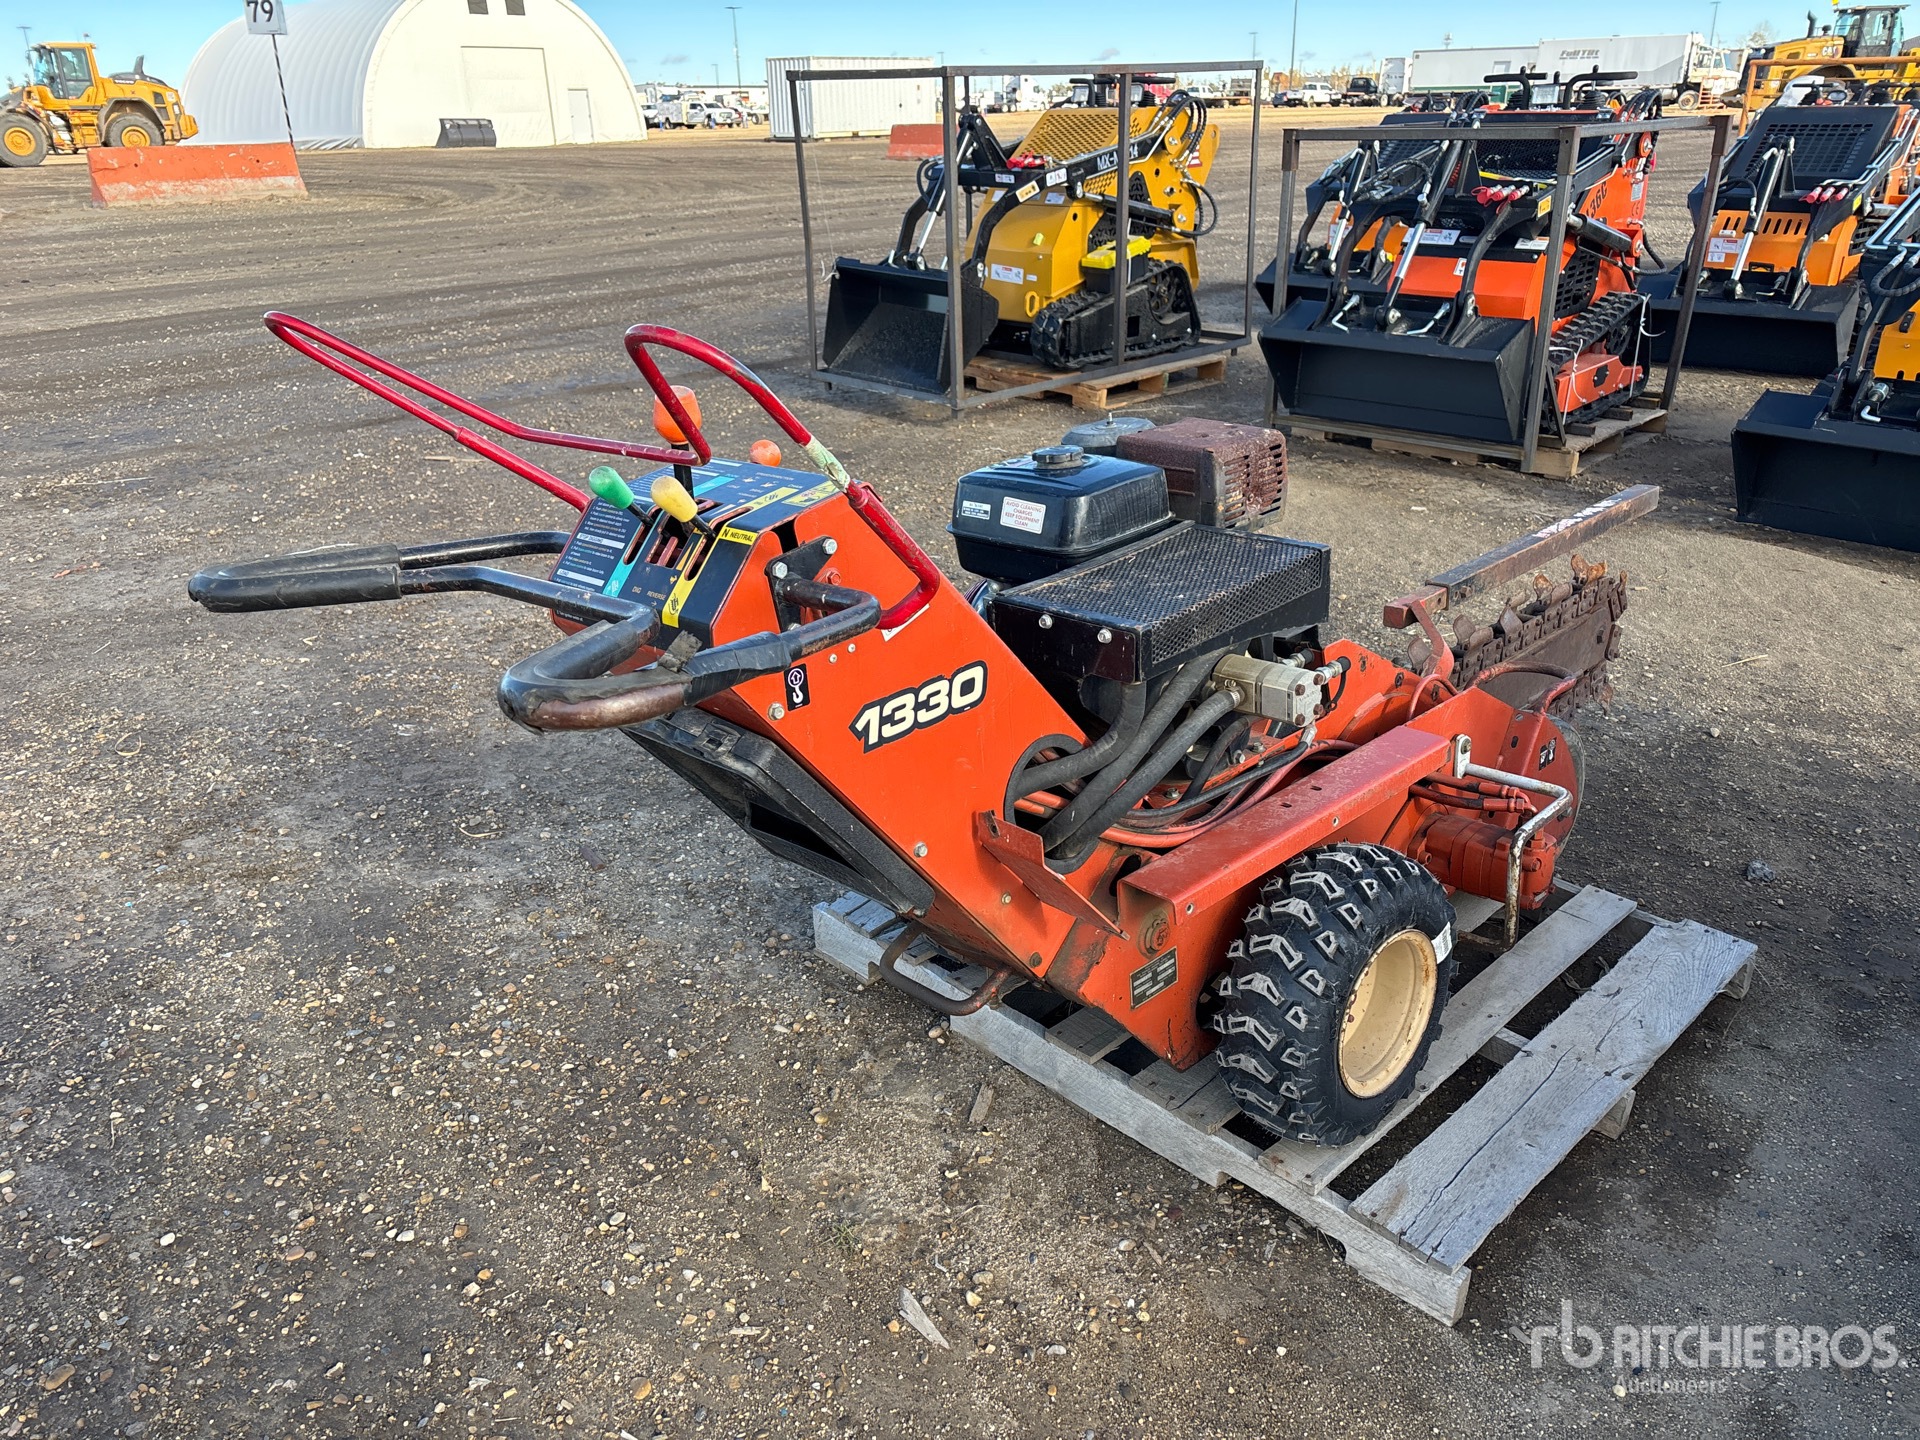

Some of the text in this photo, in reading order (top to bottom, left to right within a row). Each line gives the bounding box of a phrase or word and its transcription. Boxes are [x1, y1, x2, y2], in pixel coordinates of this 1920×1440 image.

[247, 0, 274, 23] 79
[1013, 508, 1033, 517] CHARGES
[1020, 503, 1043, 513] CLEANING
[1015, 514, 1040, 524] EQUIPMENT
[721, 527, 754, 542] N NEUTRAL
[632, 586, 642, 594] DIG
[646, 590, 666, 600] REVERSE
[854, 664, 985, 747] 1330
